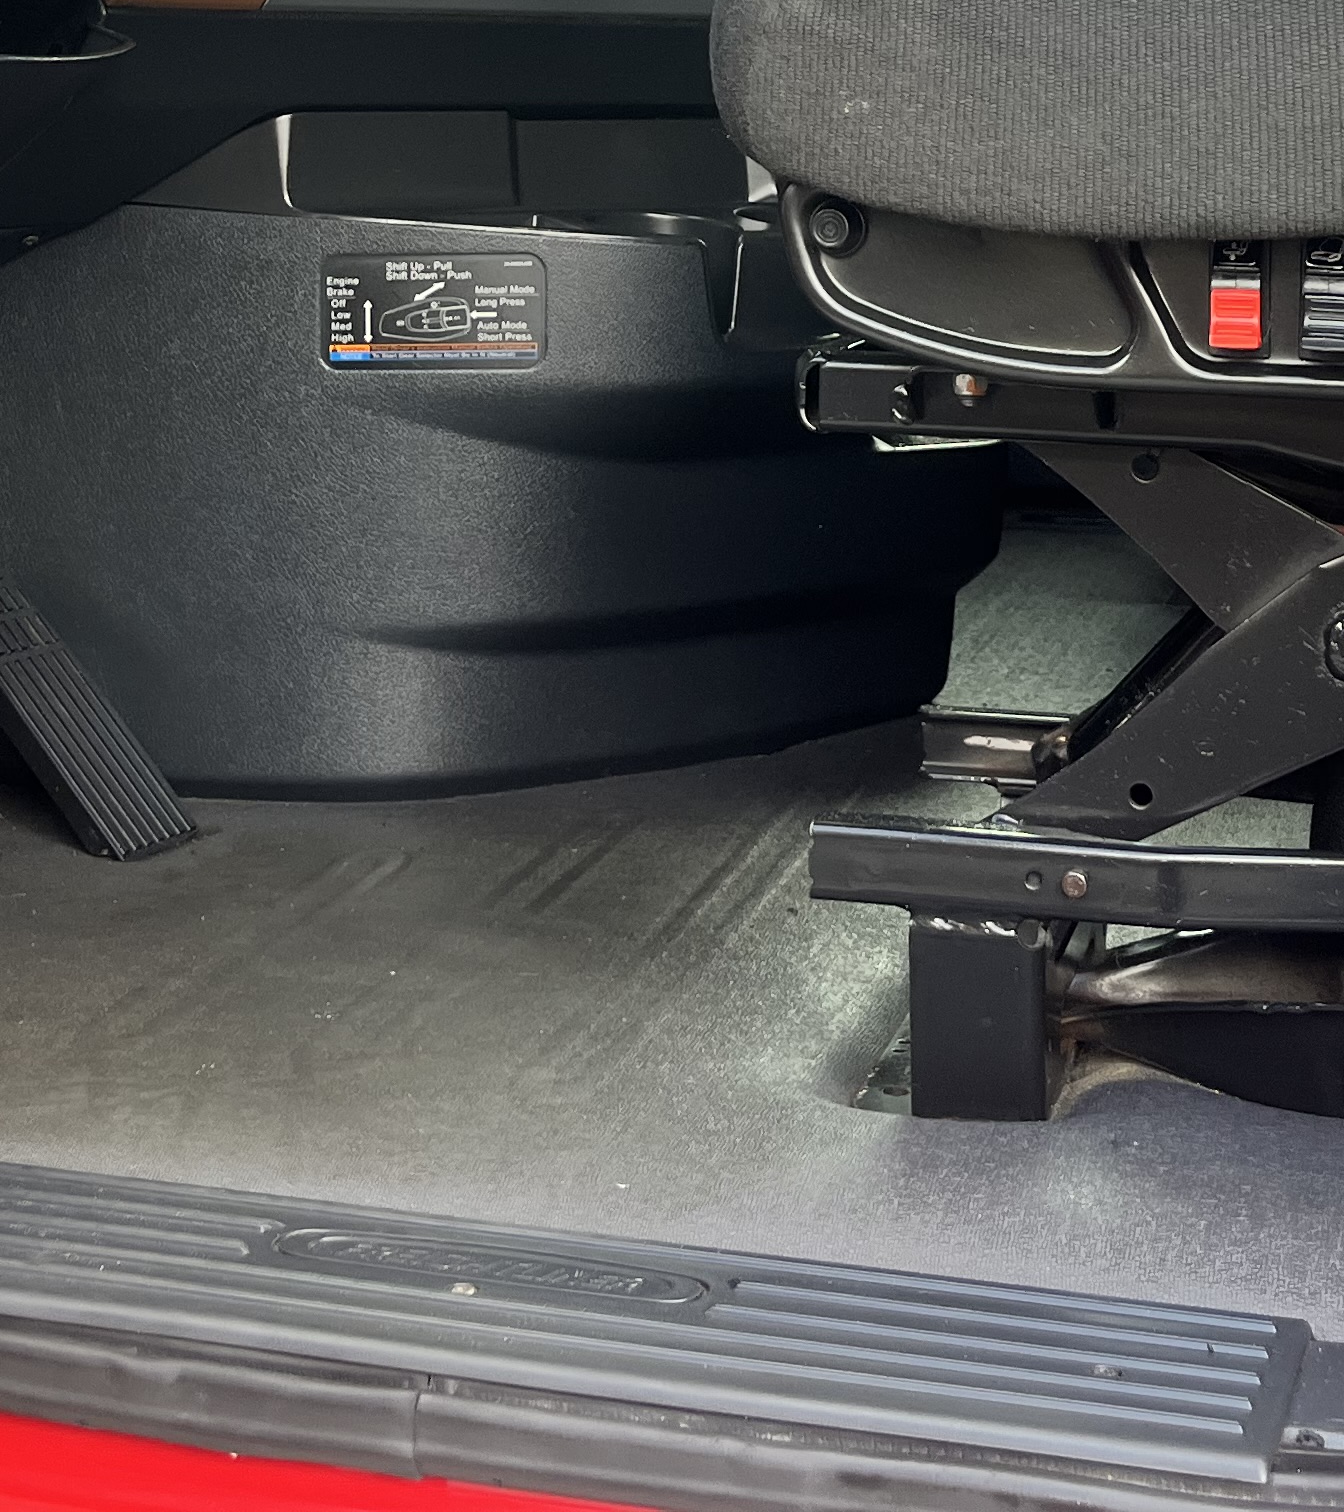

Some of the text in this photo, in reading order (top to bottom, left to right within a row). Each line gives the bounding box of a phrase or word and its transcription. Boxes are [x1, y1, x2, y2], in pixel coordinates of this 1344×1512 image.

[385, 261, 408, 271] Shift
[410, 262, 424, 272] Up
[433, 261, 453, 271] Pull
[385, 271, 408, 281] Shift
[410, 271, 438, 280] Down
[446, 270, 472, 280] Push
[326, 276, 360, 287] Engine
[326, 287, 355, 297] Brake
[474, 284, 536, 295] Manual Mode
[330, 299, 347, 309] Off
[474, 297, 526, 308] Long Press
[330, 310, 352, 320] Low
[331, 321, 353, 331] Med
[477, 320, 528, 330] Auto Mode
[331, 333, 355, 344] High
[477, 332, 533, 342] Short Press
